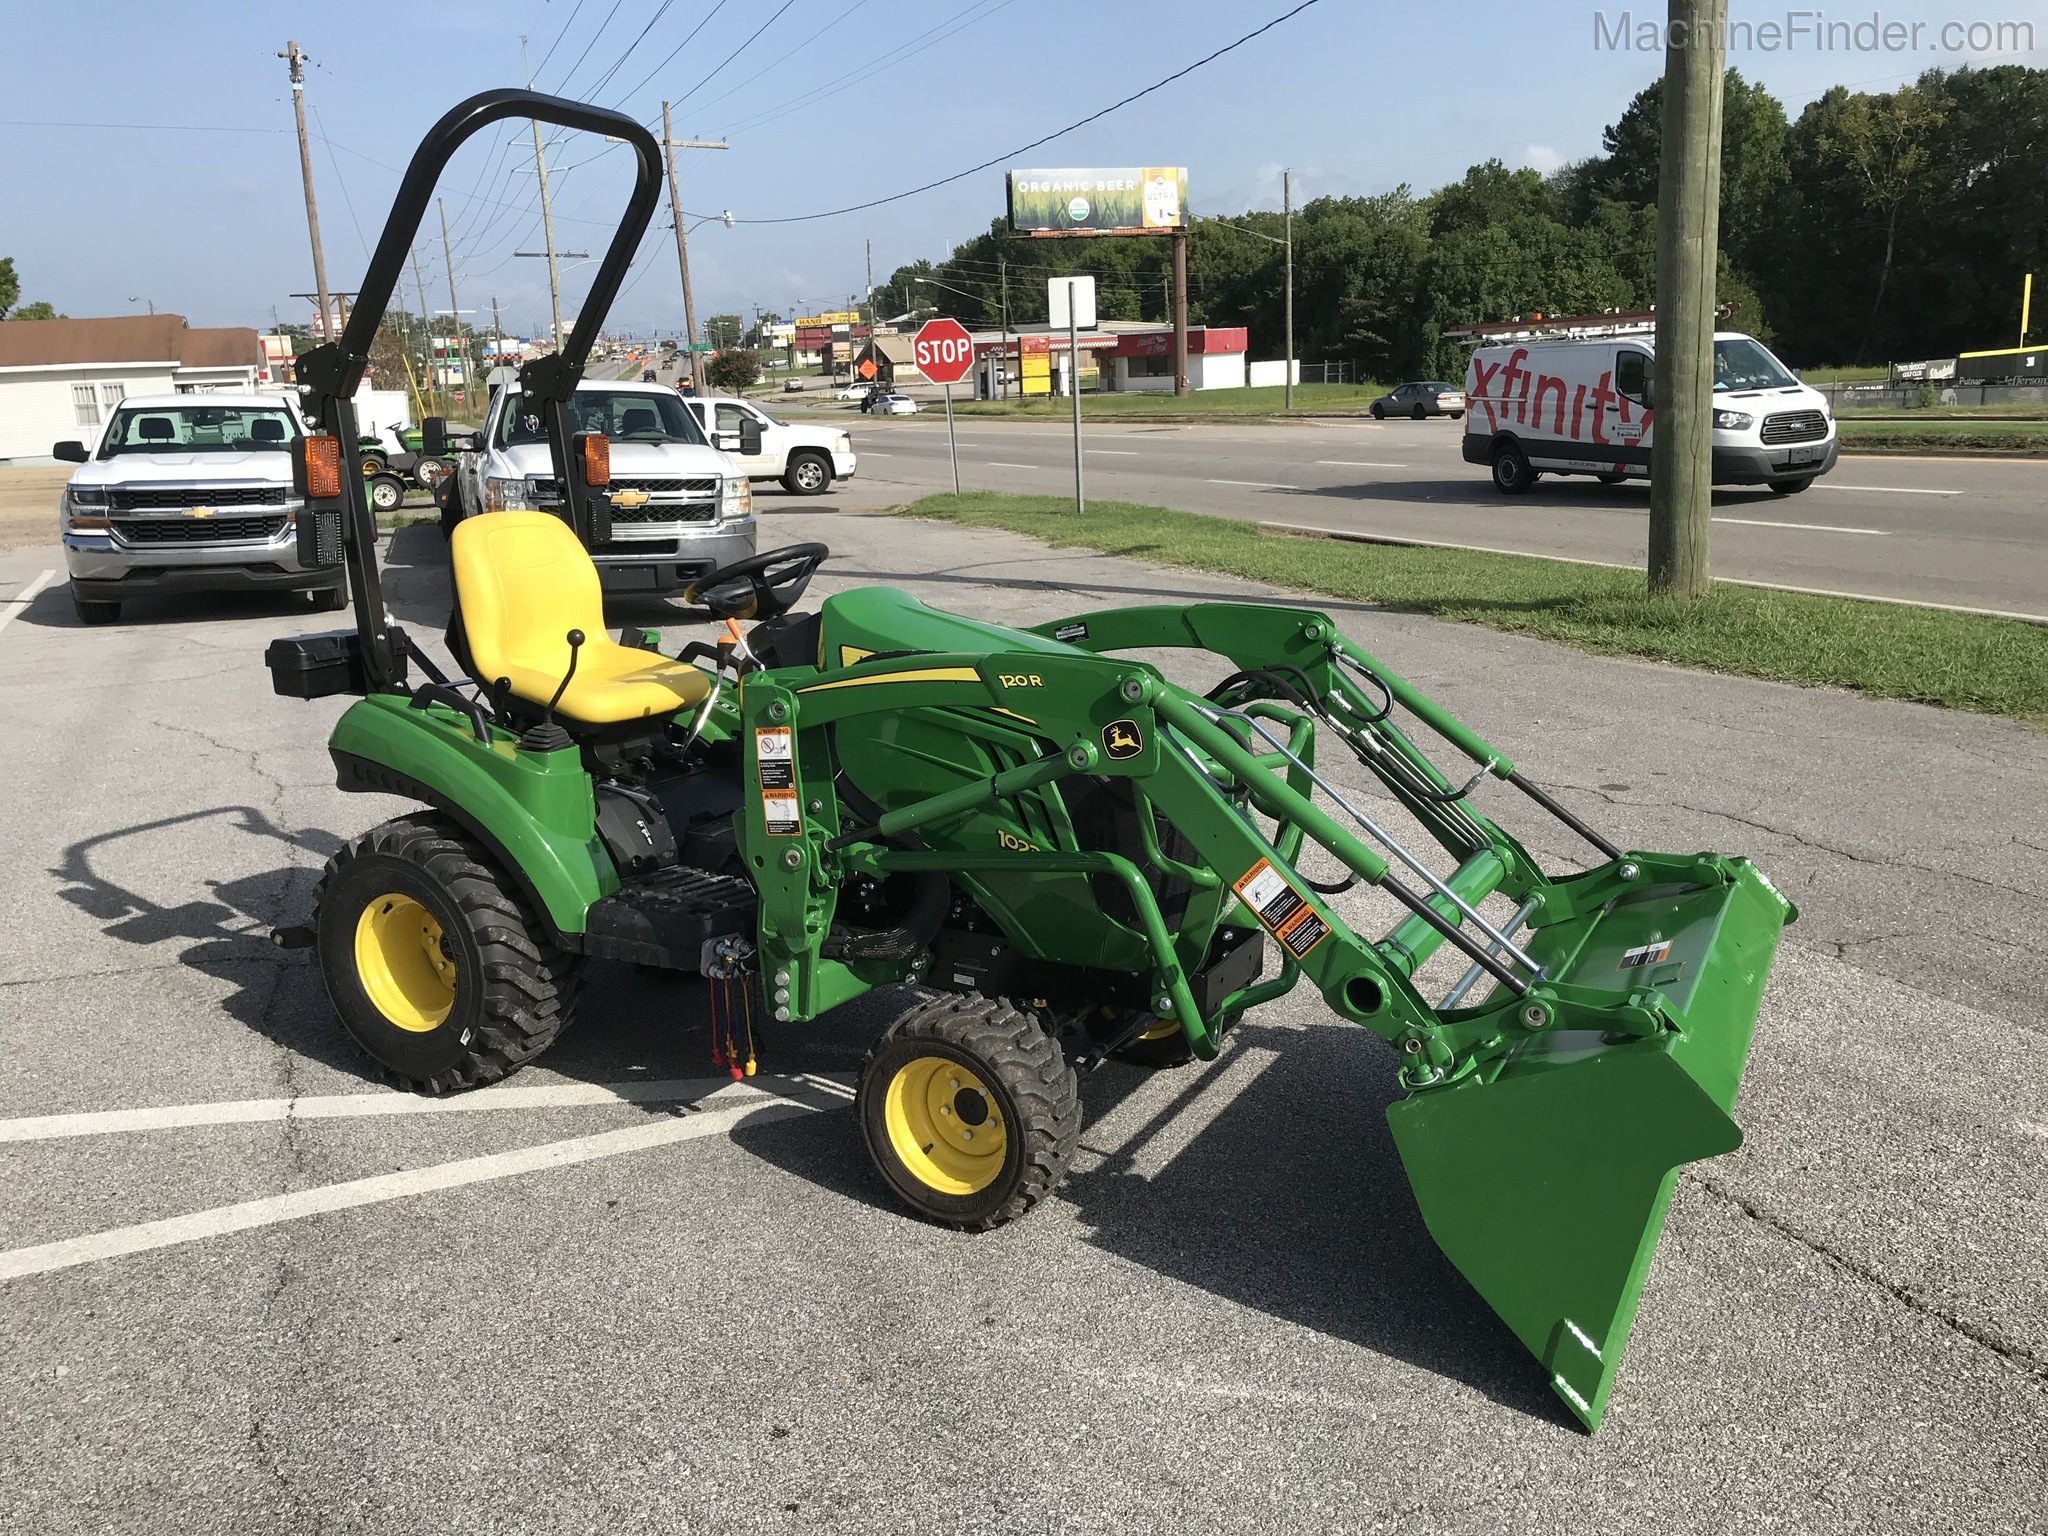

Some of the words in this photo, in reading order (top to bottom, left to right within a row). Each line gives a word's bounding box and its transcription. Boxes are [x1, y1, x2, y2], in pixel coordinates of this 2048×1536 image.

[1018, 181, 1090, 193] ORGANIC
[1096, 180, 1135, 191] BEER
[1147, 192, 1175, 201] ULTRA
[917, 338, 970, 365] STOP
[1467, 348, 1654, 447] xfinity
[762, 727, 789, 735] WARNING
[1243, 862, 1265, 883] WARNING
[1287, 909, 1310, 931] WARNING
